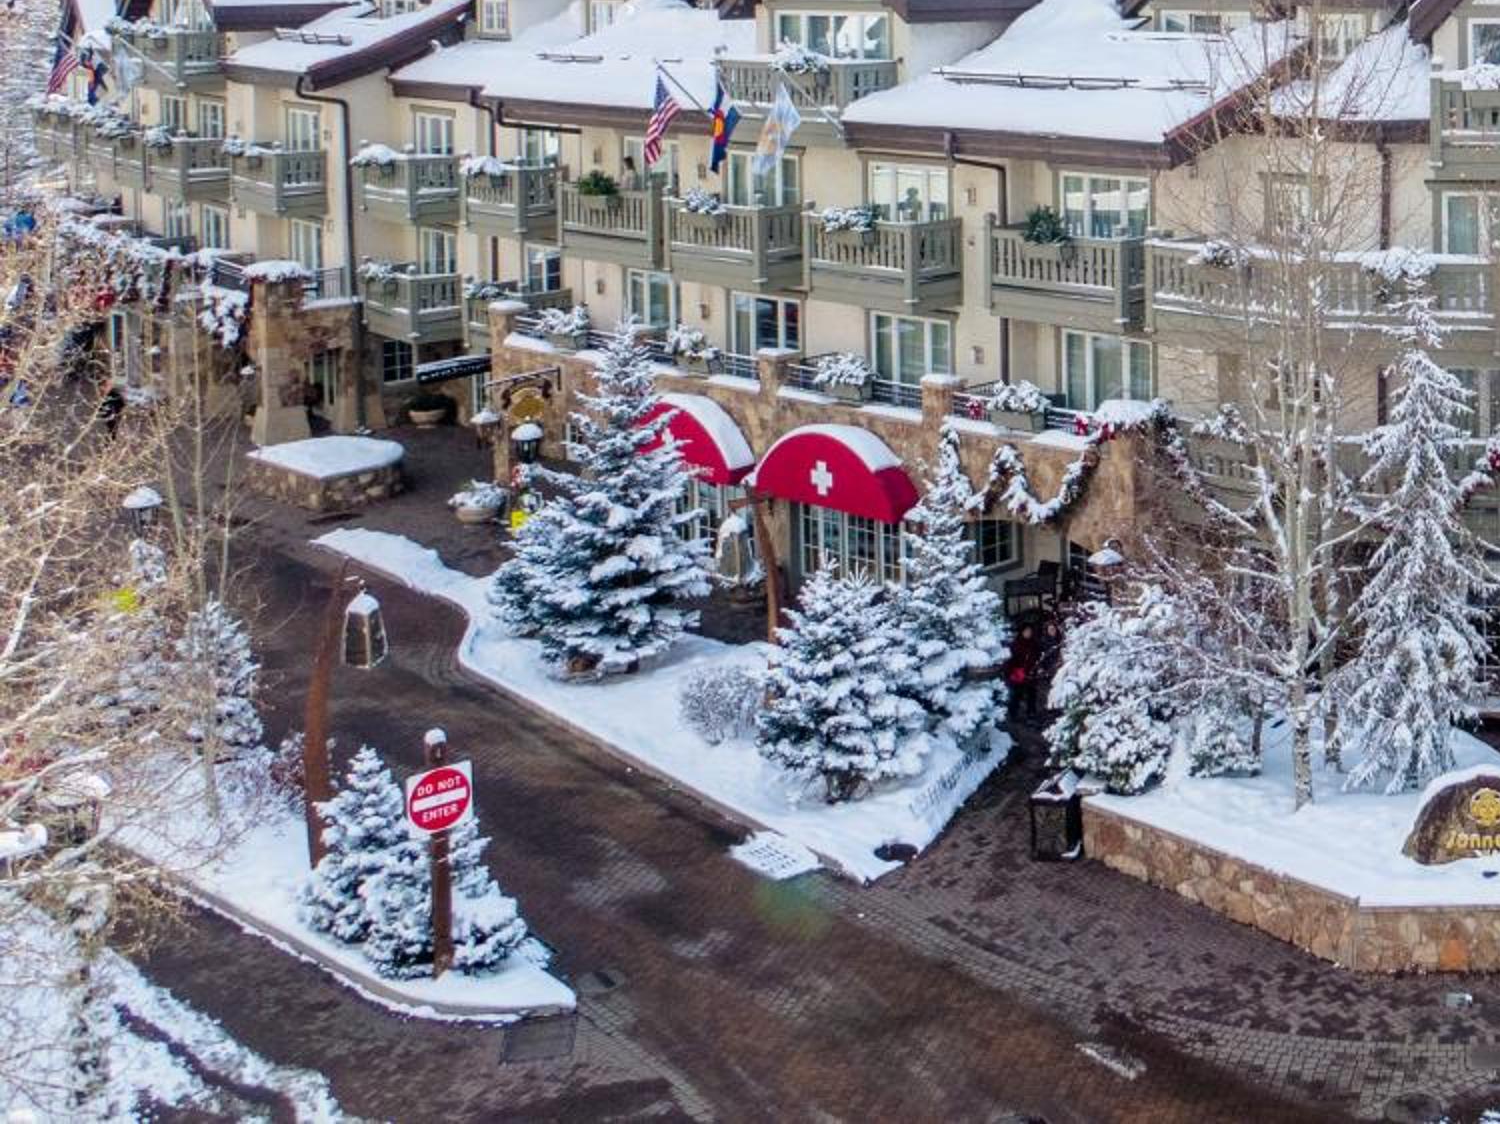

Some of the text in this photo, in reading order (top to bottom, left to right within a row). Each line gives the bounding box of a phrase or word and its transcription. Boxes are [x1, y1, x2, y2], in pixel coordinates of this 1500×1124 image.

[417, 775, 461, 797] DO NOT
[422, 803, 459, 823] ENTER
